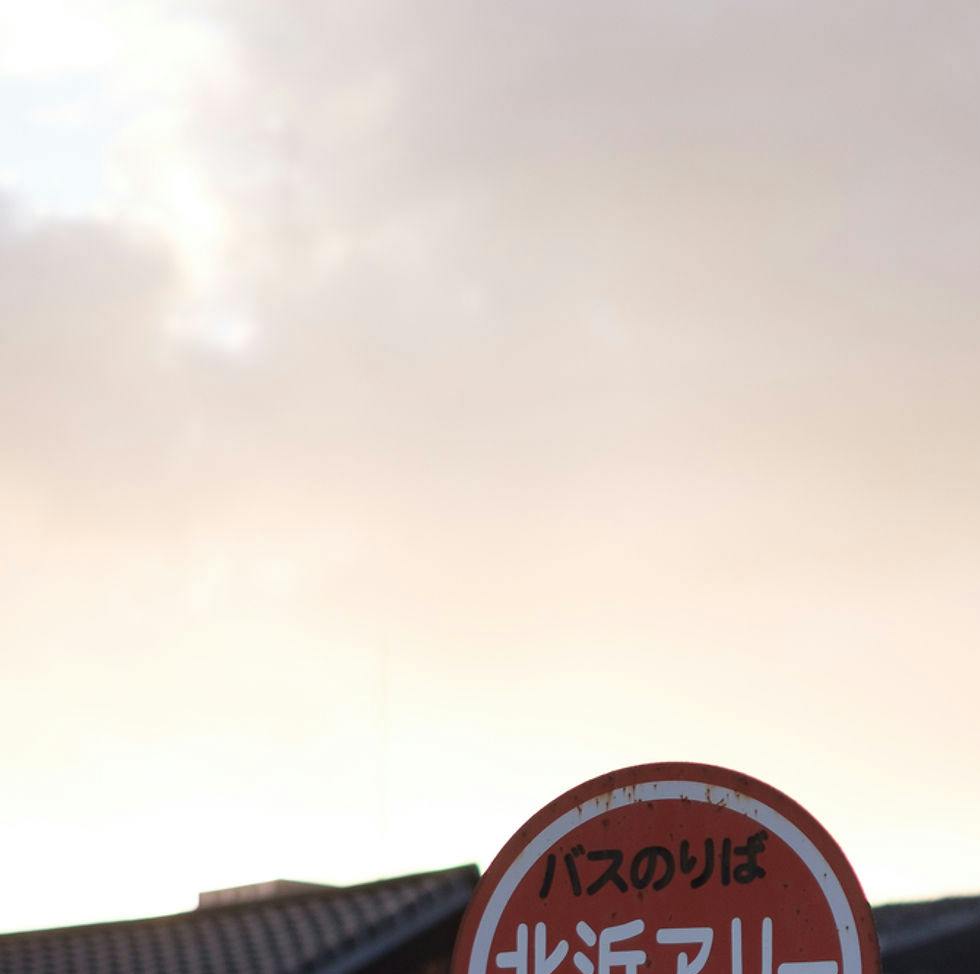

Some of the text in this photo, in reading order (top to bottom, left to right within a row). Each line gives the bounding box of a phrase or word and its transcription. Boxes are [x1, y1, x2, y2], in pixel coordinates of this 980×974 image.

[540, 832, 768, 899] バスのりば
